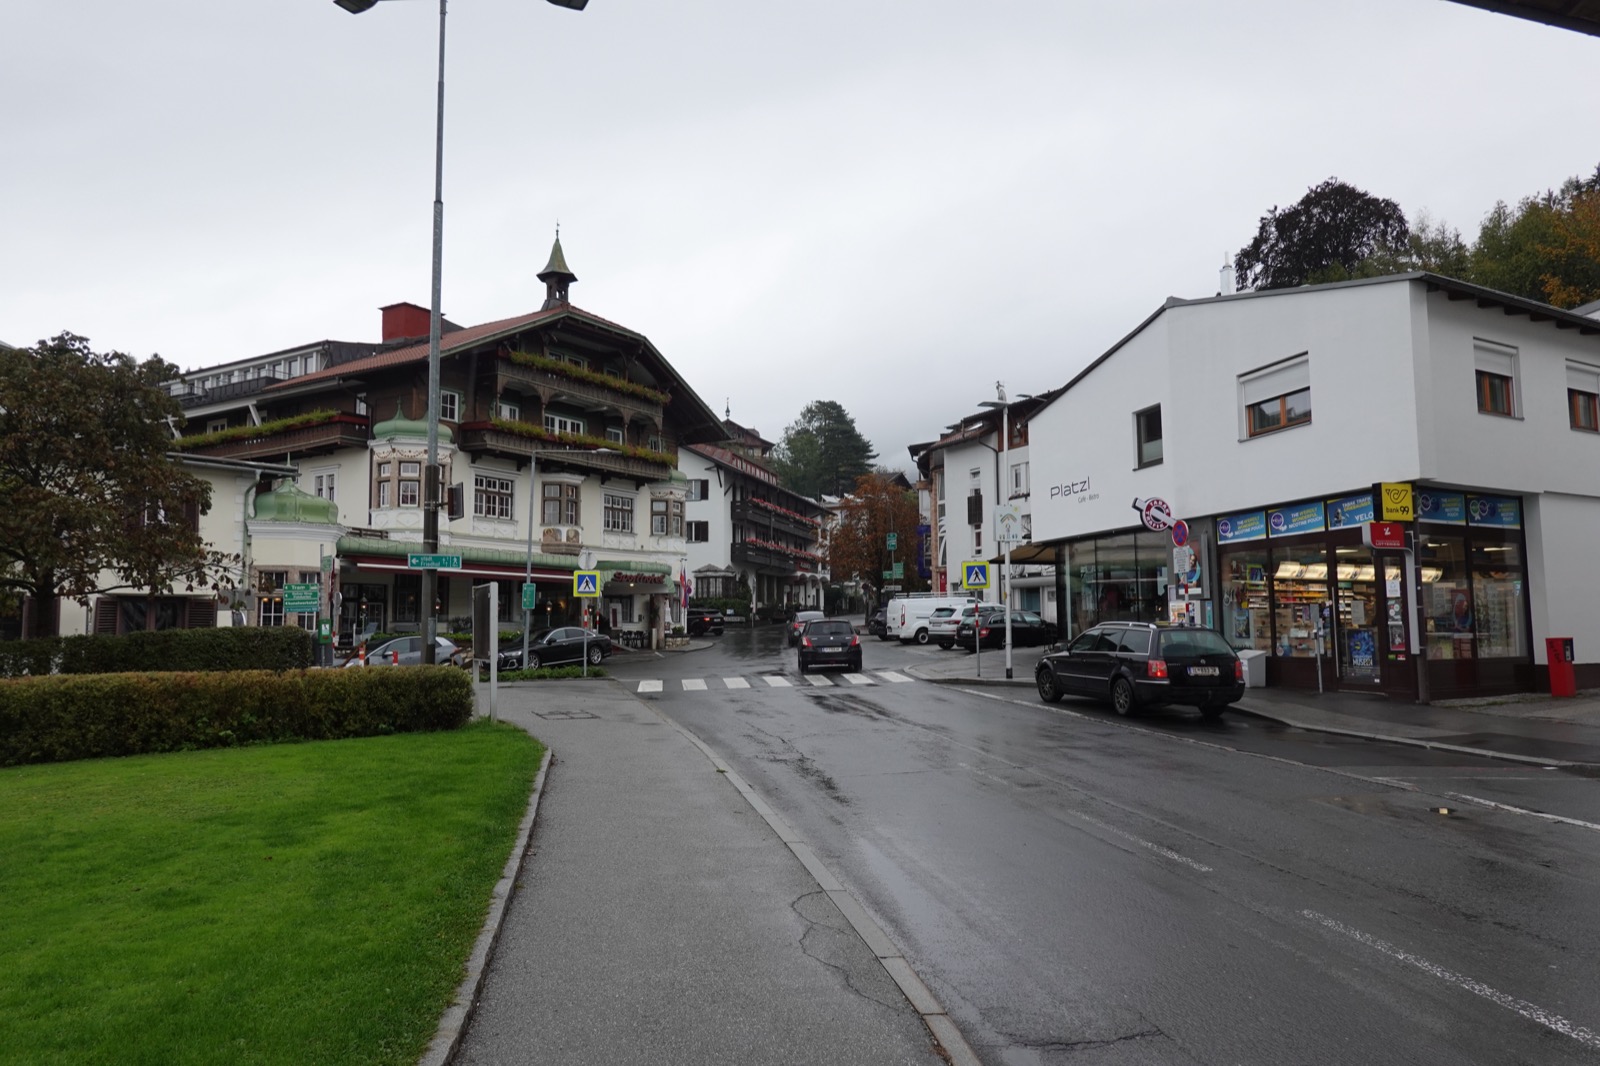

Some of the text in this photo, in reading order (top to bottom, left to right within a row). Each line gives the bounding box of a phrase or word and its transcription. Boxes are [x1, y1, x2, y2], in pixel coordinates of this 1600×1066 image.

[1050, 475, 1090, 500] Platzl
[1149, 500, 1170, 514] TABAK
[1399, 505, 1410, 515] 99
[1145, 510, 1165, 529] TRAFIK
[1307, 516, 1323, 524] POUCH
[1354, 511, 1374, 522] VELO
